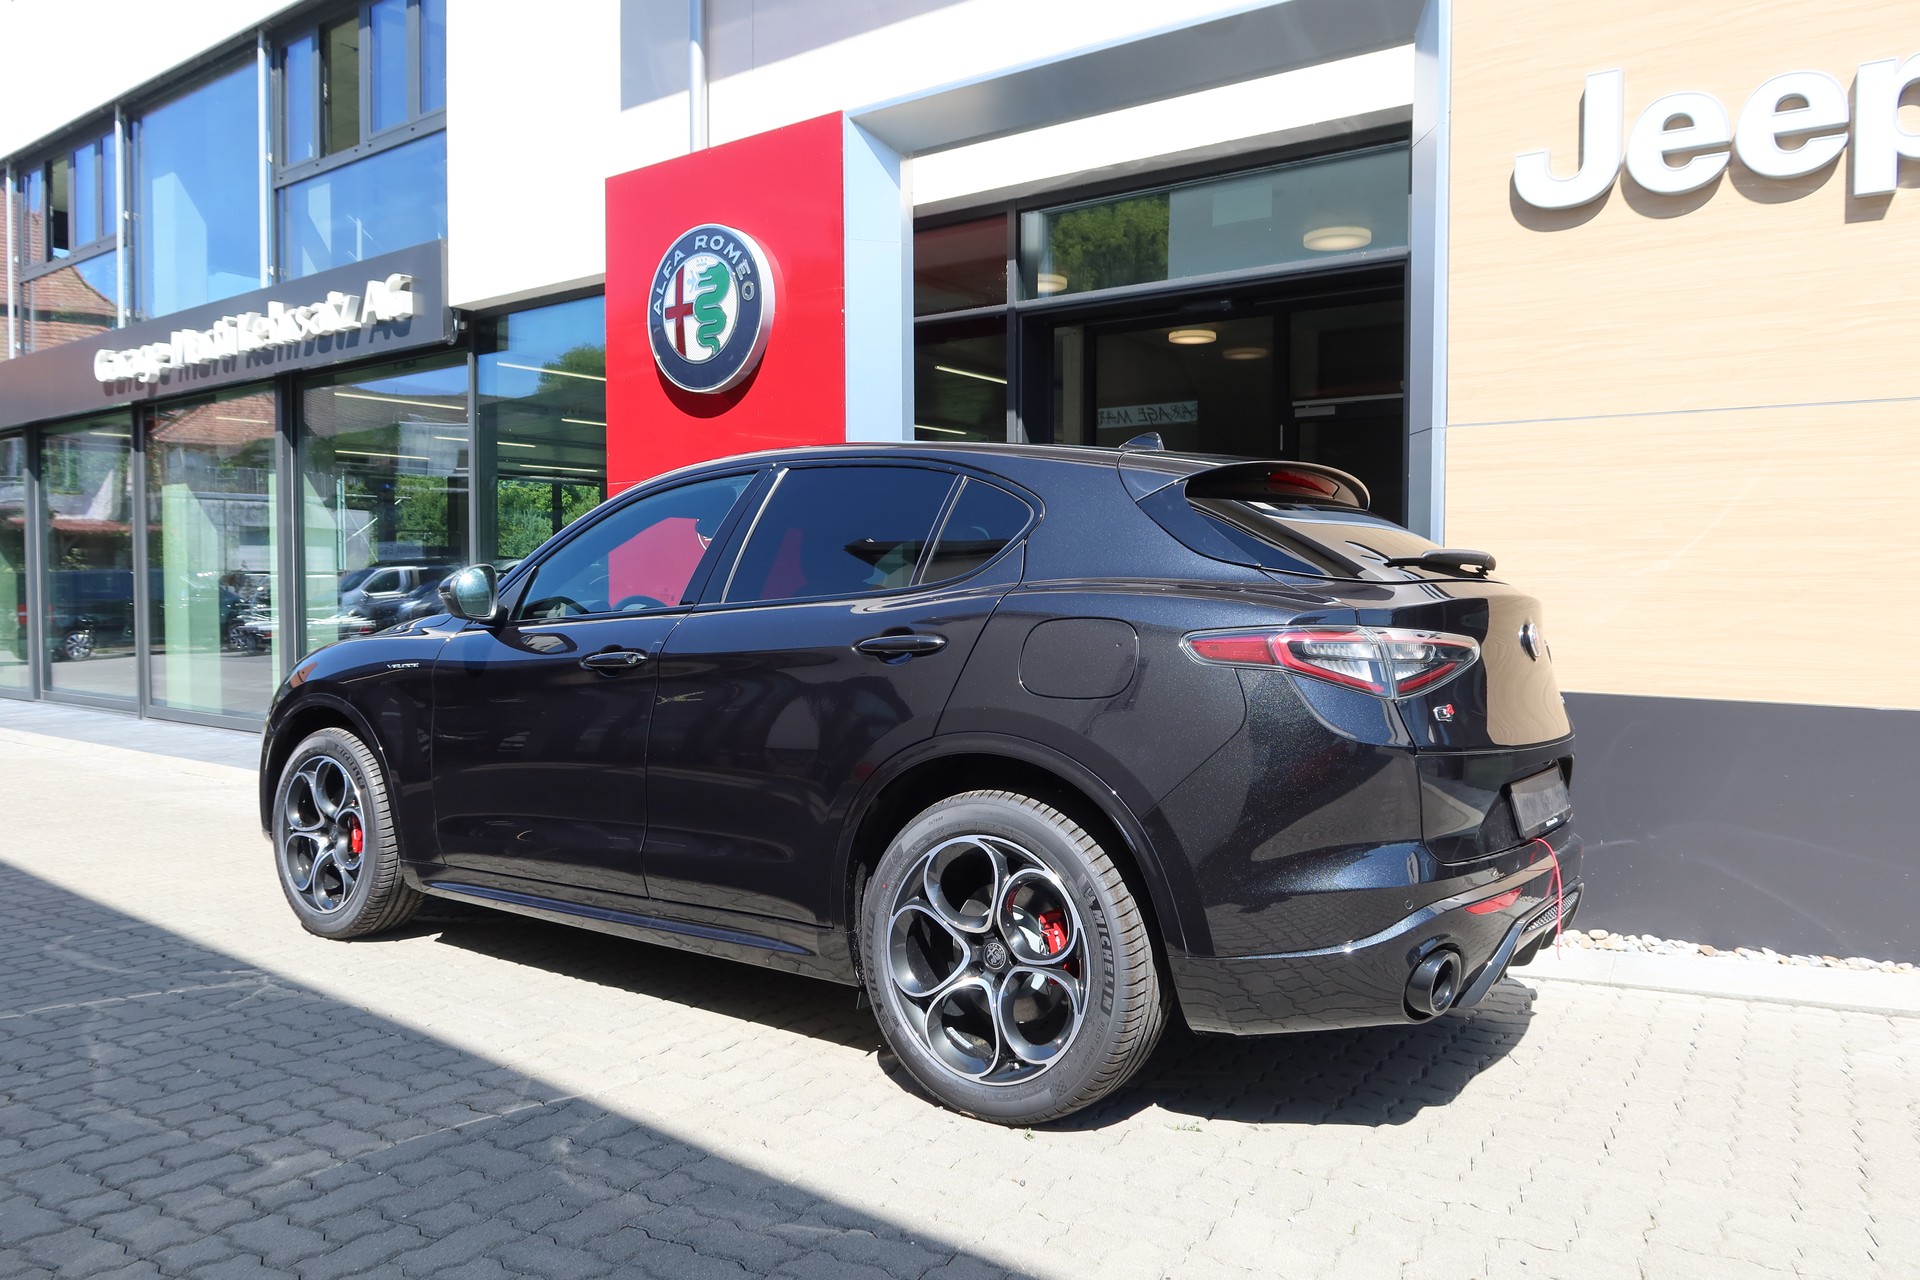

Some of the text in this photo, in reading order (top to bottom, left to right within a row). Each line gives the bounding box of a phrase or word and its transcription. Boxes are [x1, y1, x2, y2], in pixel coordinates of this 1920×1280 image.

[1513, 52, 1920, 209] Jeep
[361, 273, 414, 323] AG
[653, 235, 756, 316] ALFA ROMEO
[1093, 908, 1114, 1012] MICHELIN
[1094, 1020, 1105, 1046] PILOT
